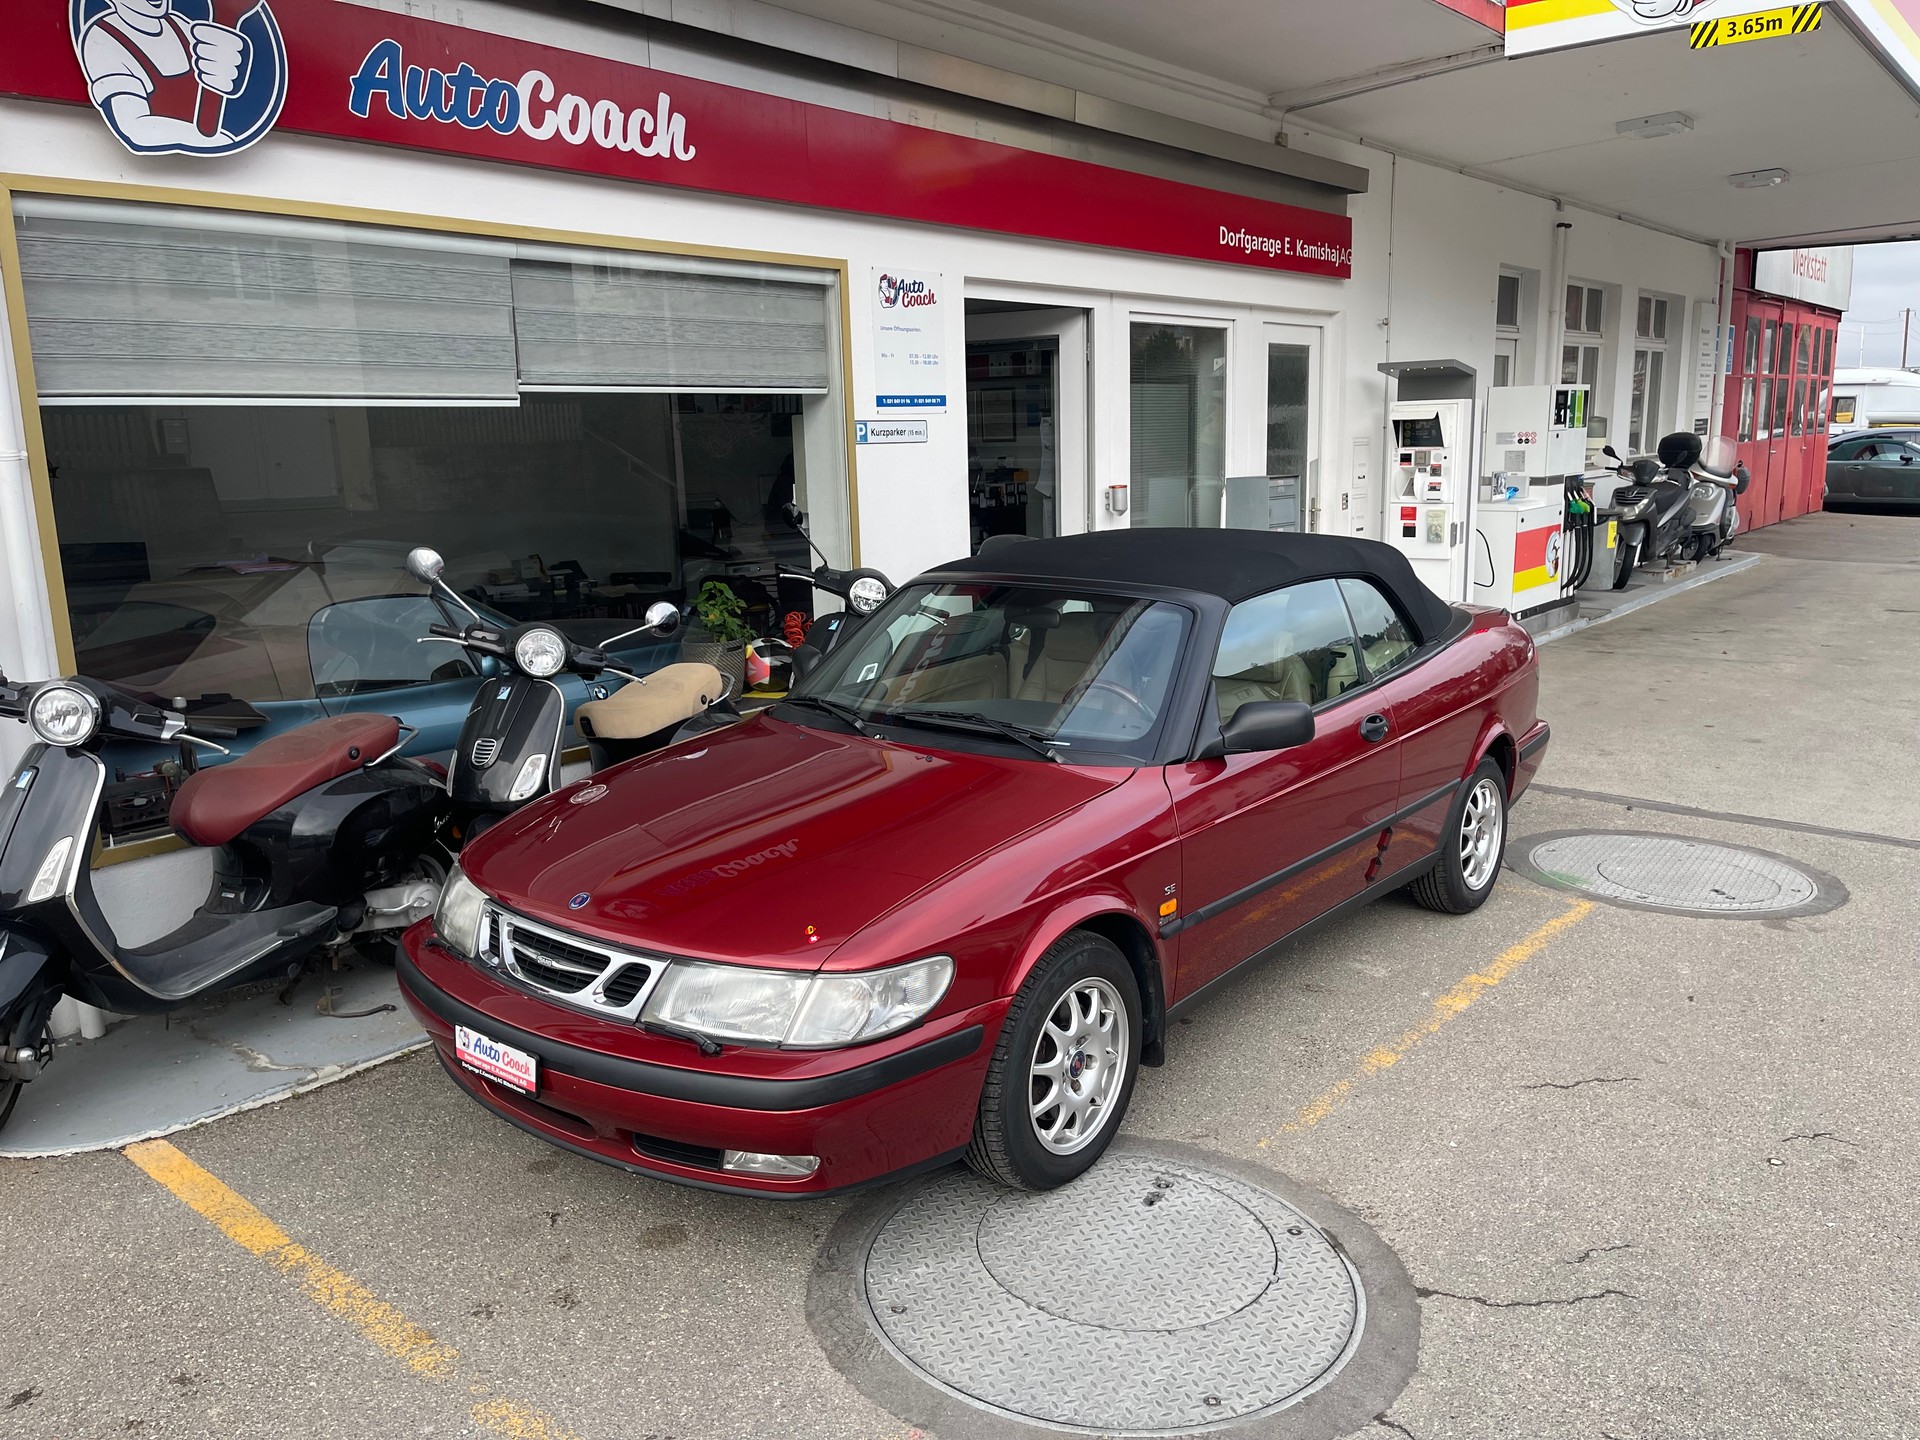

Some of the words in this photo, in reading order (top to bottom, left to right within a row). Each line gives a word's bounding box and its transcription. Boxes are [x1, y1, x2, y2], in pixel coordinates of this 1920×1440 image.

[1726, 16, 1783, 38] 3.65m
[1219, 226, 1282, 257] Dorfgarage
[1284, 237, 1294, 256] E.
[1296, 239, 1340, 267] Kamishaj
[1340, 247, 1352, 265] AG
[1792, 248, 1827, 284] Werkstatt
[897, 278, 925, 296] Auto
[901, 288, 938, 308] Coach
[856, 424, 867, 442] P
[870, 428, 907, 438] Kurzparker
[1164, 882, 1176, 896] SE
[464, 1052, 491, 1070] Dorfgarage
[473, 1037, 501, 1063] Auto
[501, 1051, 532, 1077] Coach
